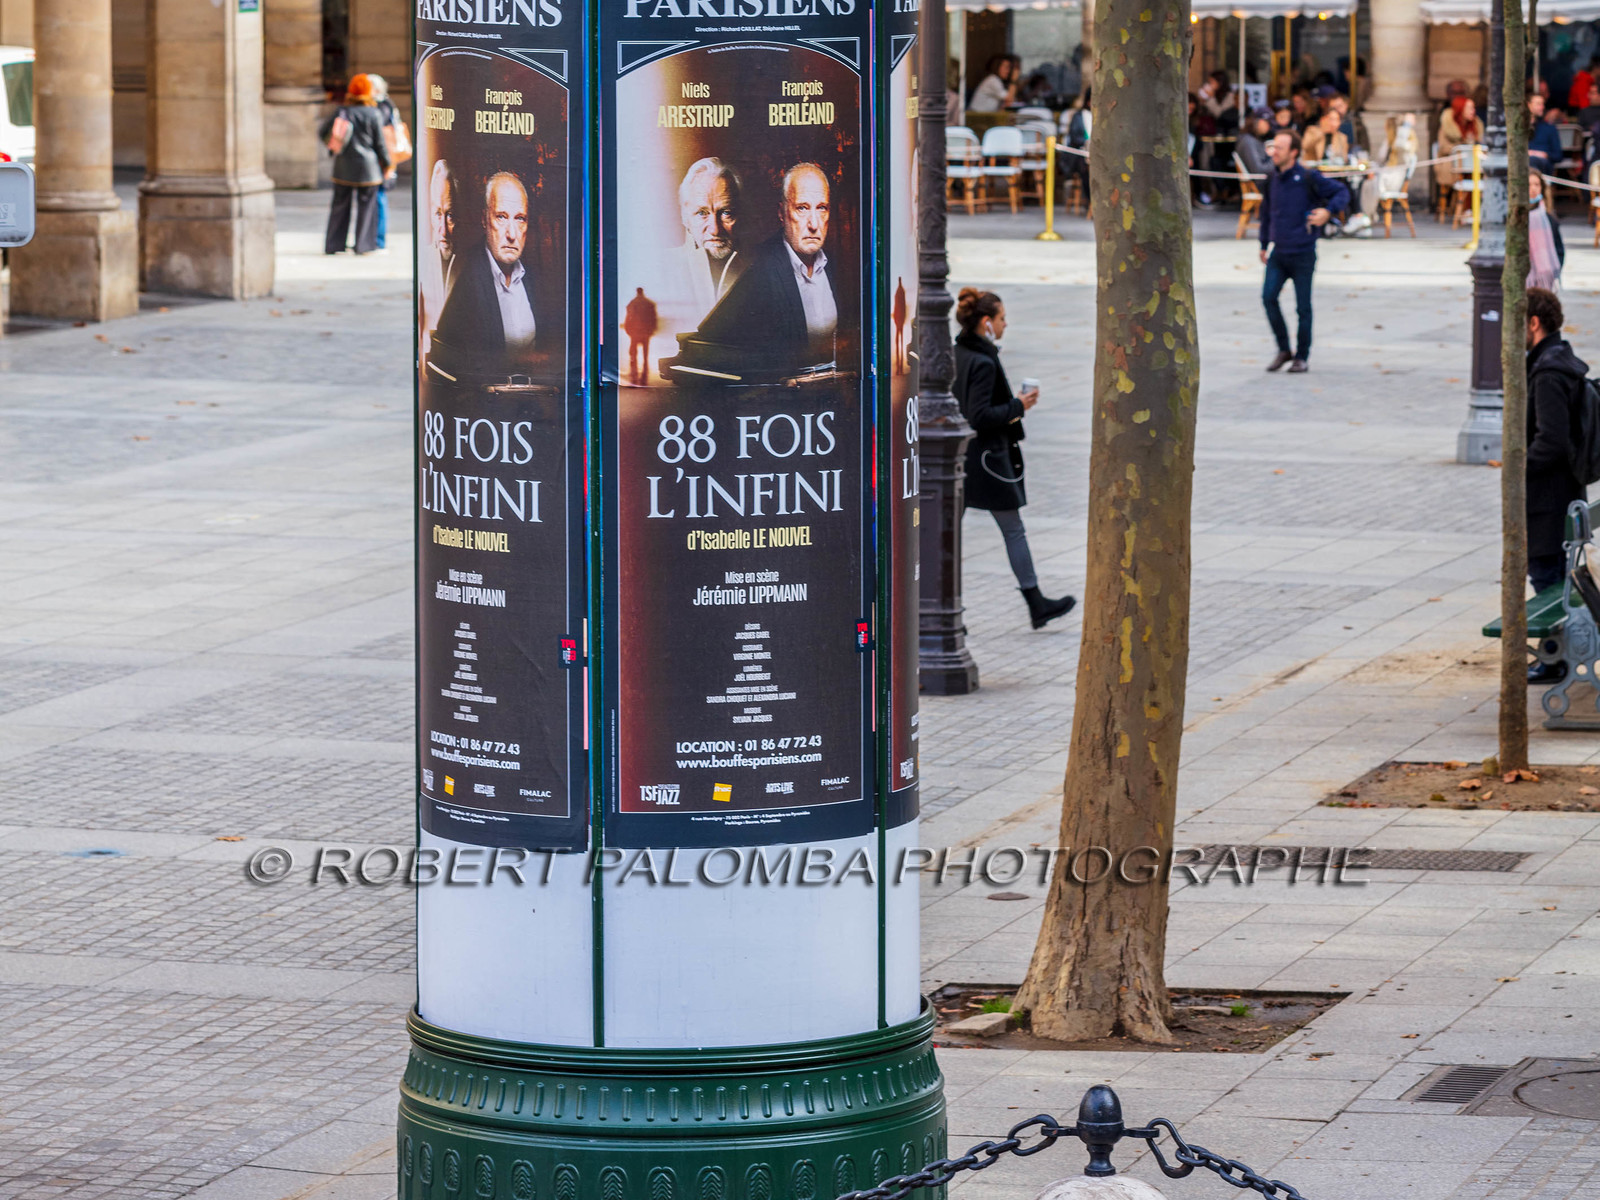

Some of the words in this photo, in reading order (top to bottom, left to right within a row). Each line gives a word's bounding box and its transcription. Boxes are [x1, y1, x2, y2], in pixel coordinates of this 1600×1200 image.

[485, 89, 522, 106] François
[682, 82, 710, 99] Niels
[782, 80, 823, 98] François
[475, 105, 534, 135] BERLÉAND
[657, 104, 735, 128] ARESTRUP
[768, 96, 835, 126] BERLÉAND
[424, 410, 445, 459] 88
[453, 416, 534, 465] FOIS
[657, 415, 717, 464] 88
[735, 411, 836, 458] FOIS
[422, 462, 543, 523] L'INFINI
[646, 467, 844, 519] L'INFINI
[464, 530, 474, 550] LE
[474, 530, 510, 553] NOUVEL
[753, 528, 766, 549] LE
[769, 526, 812, 548] NOUVEL
[725, 571, 744, 584] Mise
[745, 573, 755, 583] en
[756, 570, 779, 583] scène
[462, 586, 506, 608] LIPPMANN
[693, 585, 746, 606] Jérémie
[749, 583, 808, 604] LIPPMANN
[431, 730, 456, 748] LOCATION
[460, 737, 468, 749] 01
[470, 739, 481, 751] 86
[482, 741, 493, 752] 47
[494, 742, 507, 754] 72
[507, 743, 520, 755] 43
[676, 740, 735, 754] LOCATION
[745, 739, 757, 751] 01
[761, 738, 775, 750] 86
[777, 737, 792, 749] 47
[793, 736, 807, 748] 72
[808, 735, 822, 747] 43
[676, 751, 822, 770] www.bouffesparisiens.com
[821, 776, 850, 786] FIMALAC
[519, 788, 551, 798] FIMALAC
[639, 785, 658, 801] TSF
[656, 789, 680, 805] JAZZ
